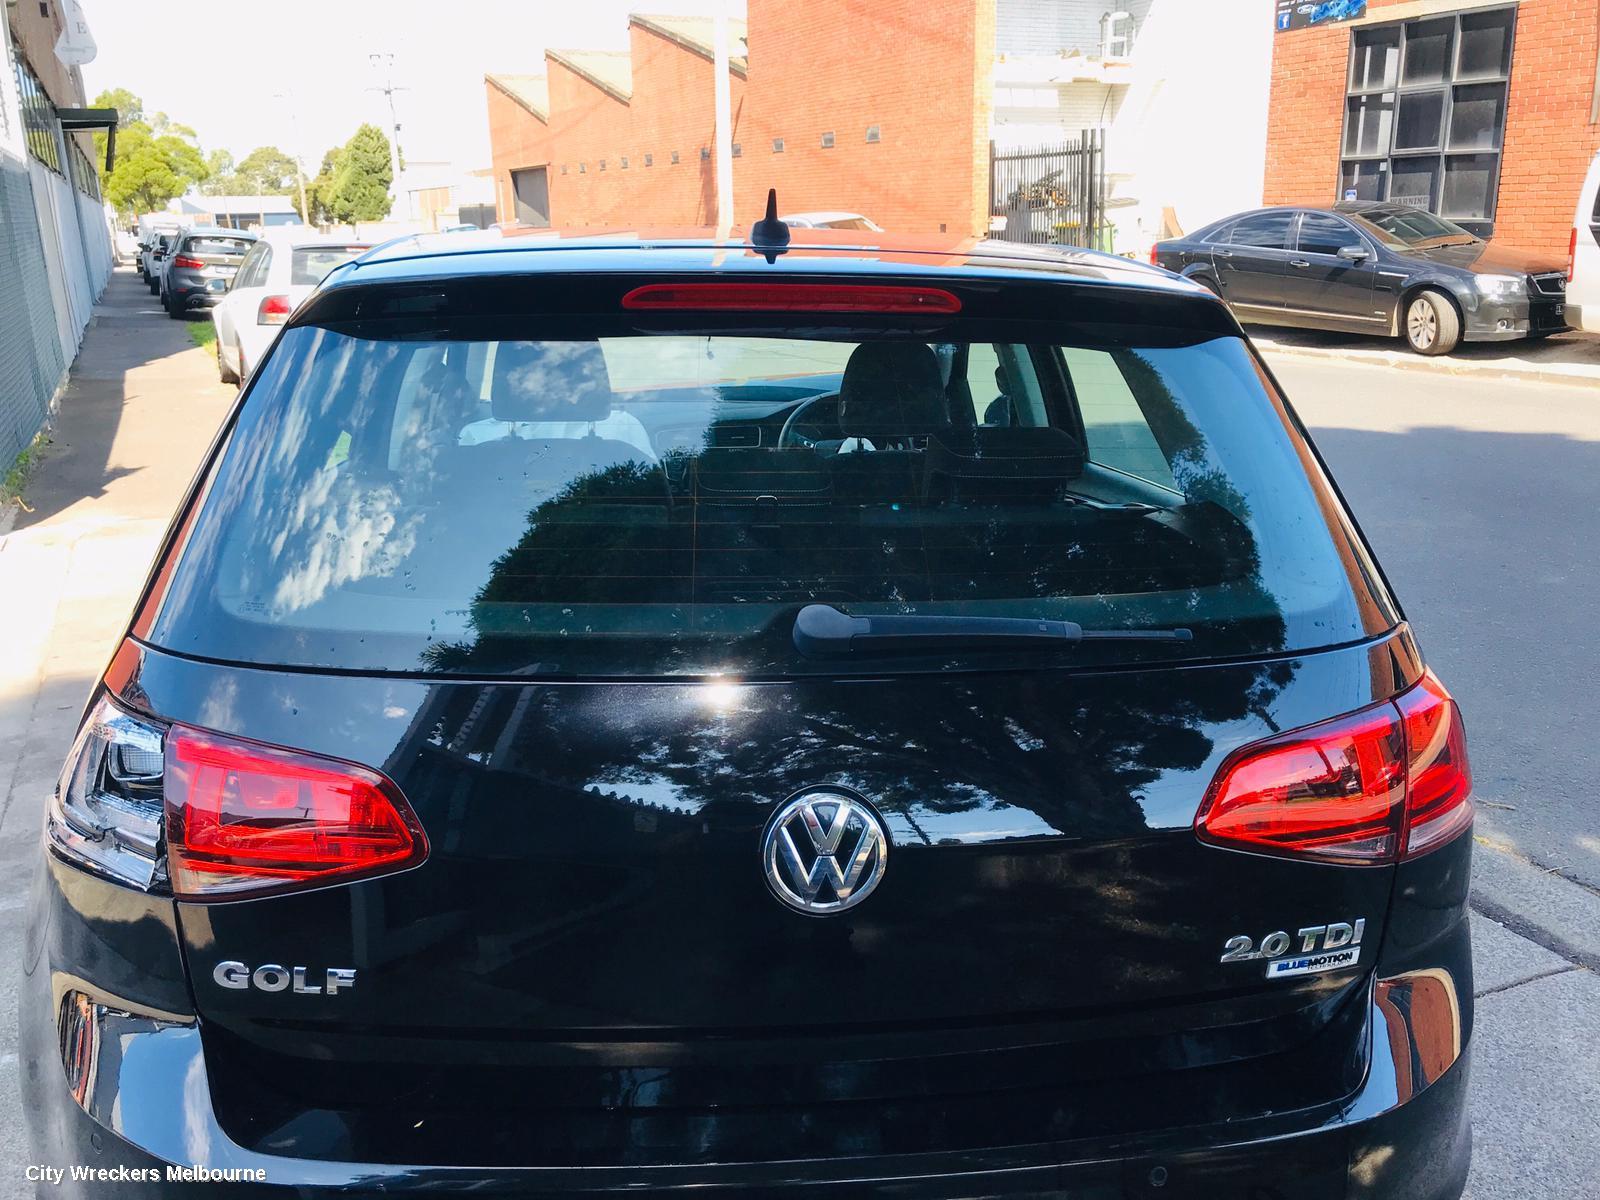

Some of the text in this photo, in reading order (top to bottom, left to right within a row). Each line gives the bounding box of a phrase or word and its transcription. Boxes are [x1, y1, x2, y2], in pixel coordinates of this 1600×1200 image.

[76, 22, 87, 34] E
[1391, 196, 1429, 206] WARNING
[1221, 918, 1365, 963] 2.0 TDI
[1277, 952, 1353, 971] BLUEMOTION
[213, 960, 357, 995] GOLF
